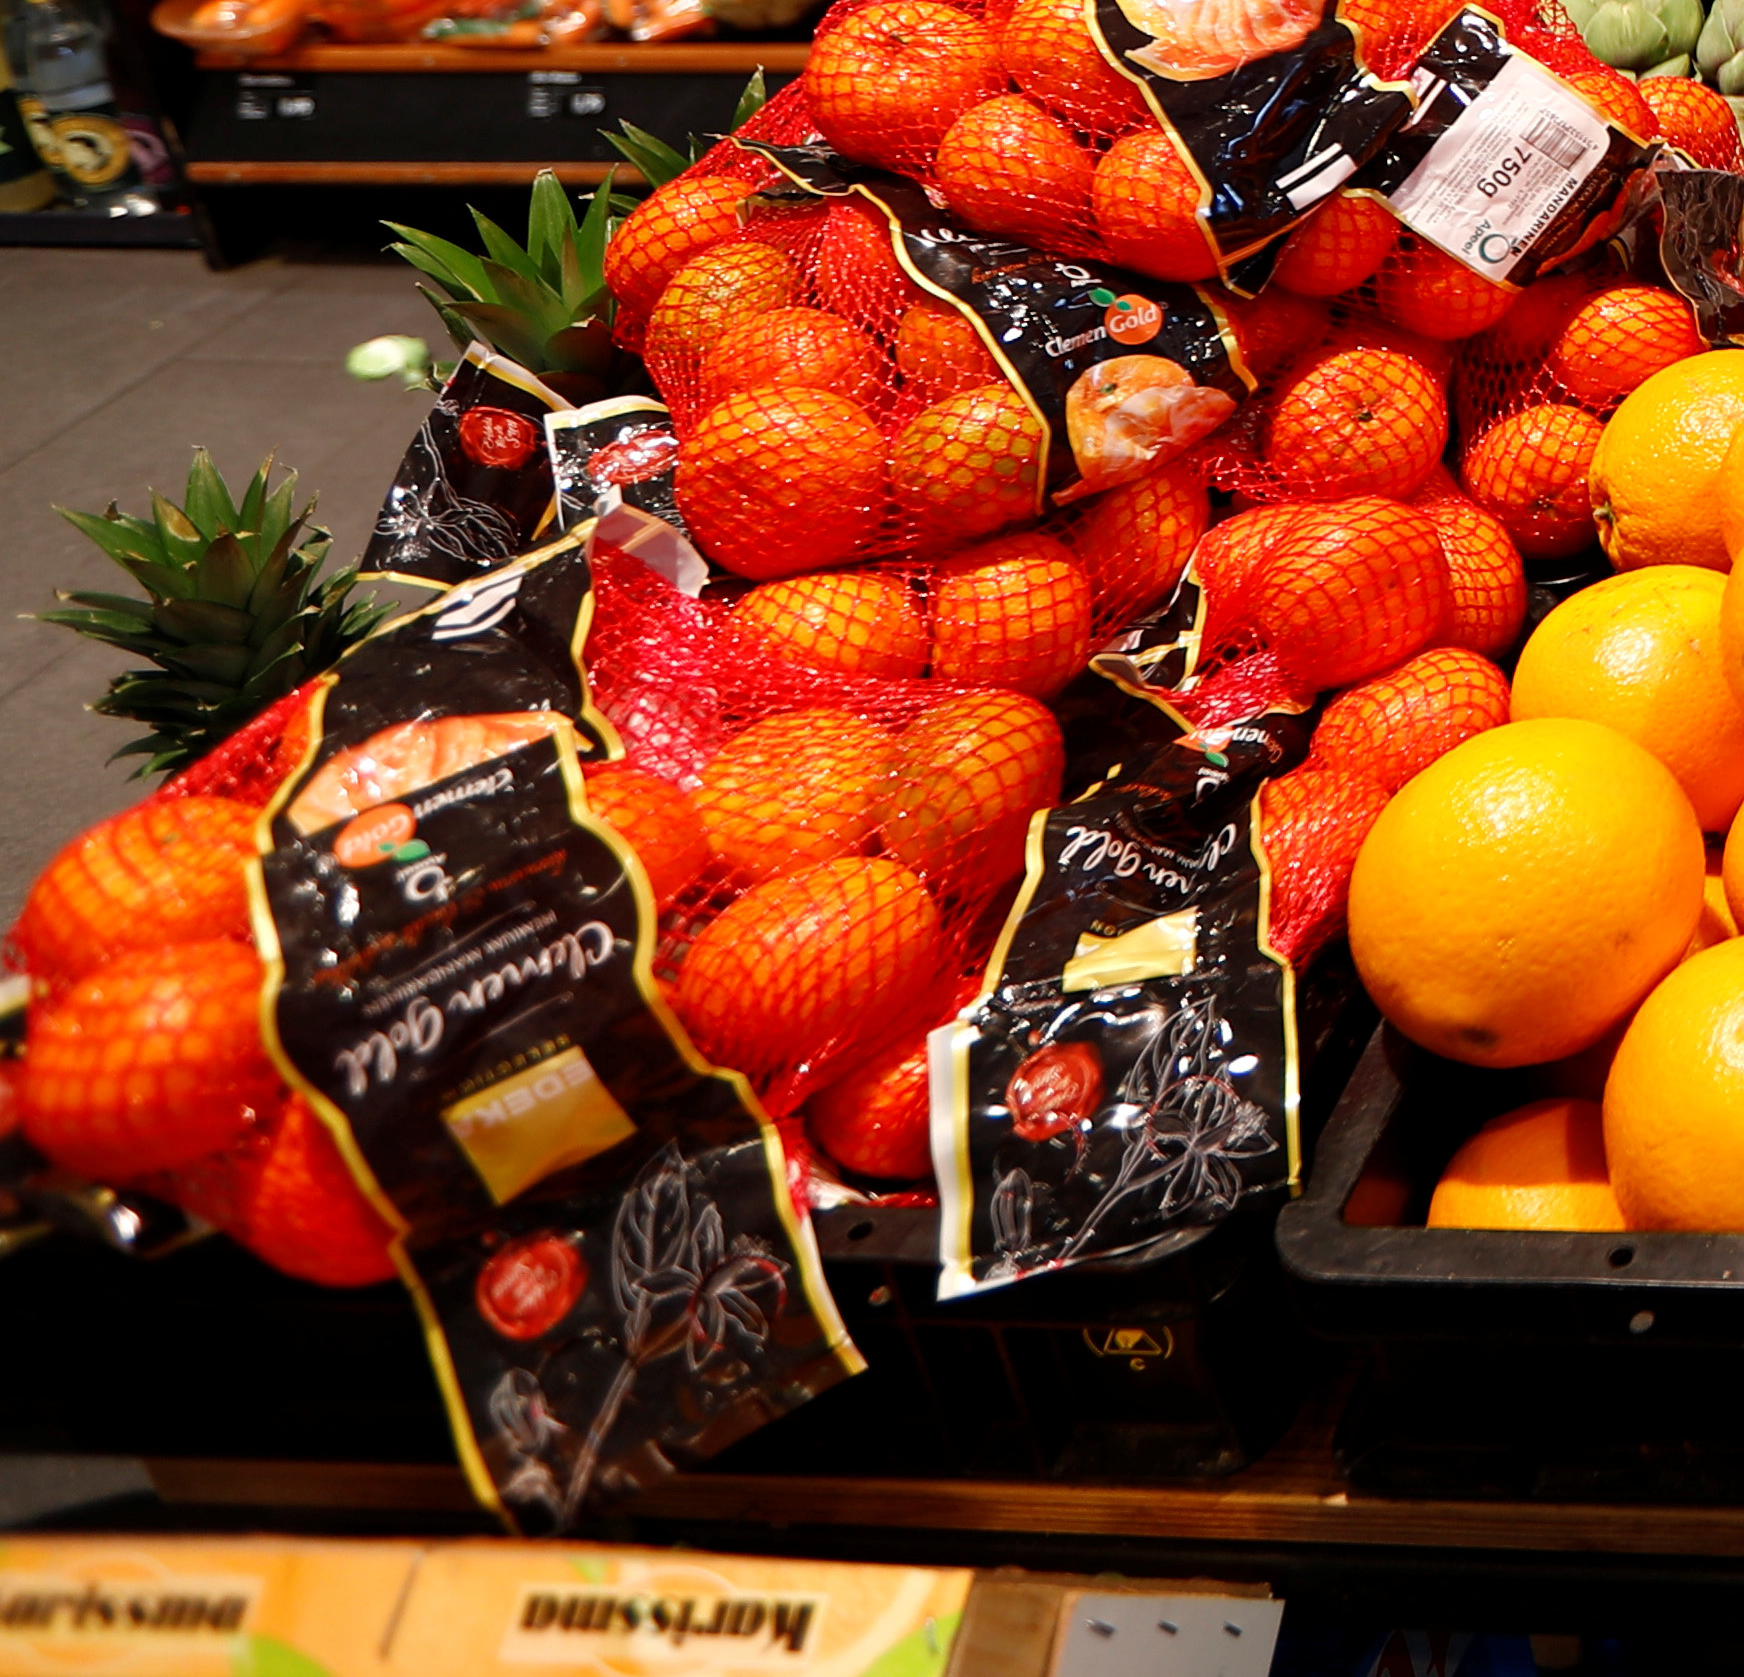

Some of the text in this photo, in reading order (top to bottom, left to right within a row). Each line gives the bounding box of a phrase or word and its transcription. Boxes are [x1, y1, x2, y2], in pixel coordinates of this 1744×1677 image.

[1476, 145, 1533, 199] 750g
[1460, 218, 1492, 257] Apeel
[1510, 176, 1578, 259] MANDARINEN
[1043, 303, 1162, 357] Clemen Gold
[453, 915, 620, 1033] Clemen
[519, 1583, 817, 1653] Karissma
